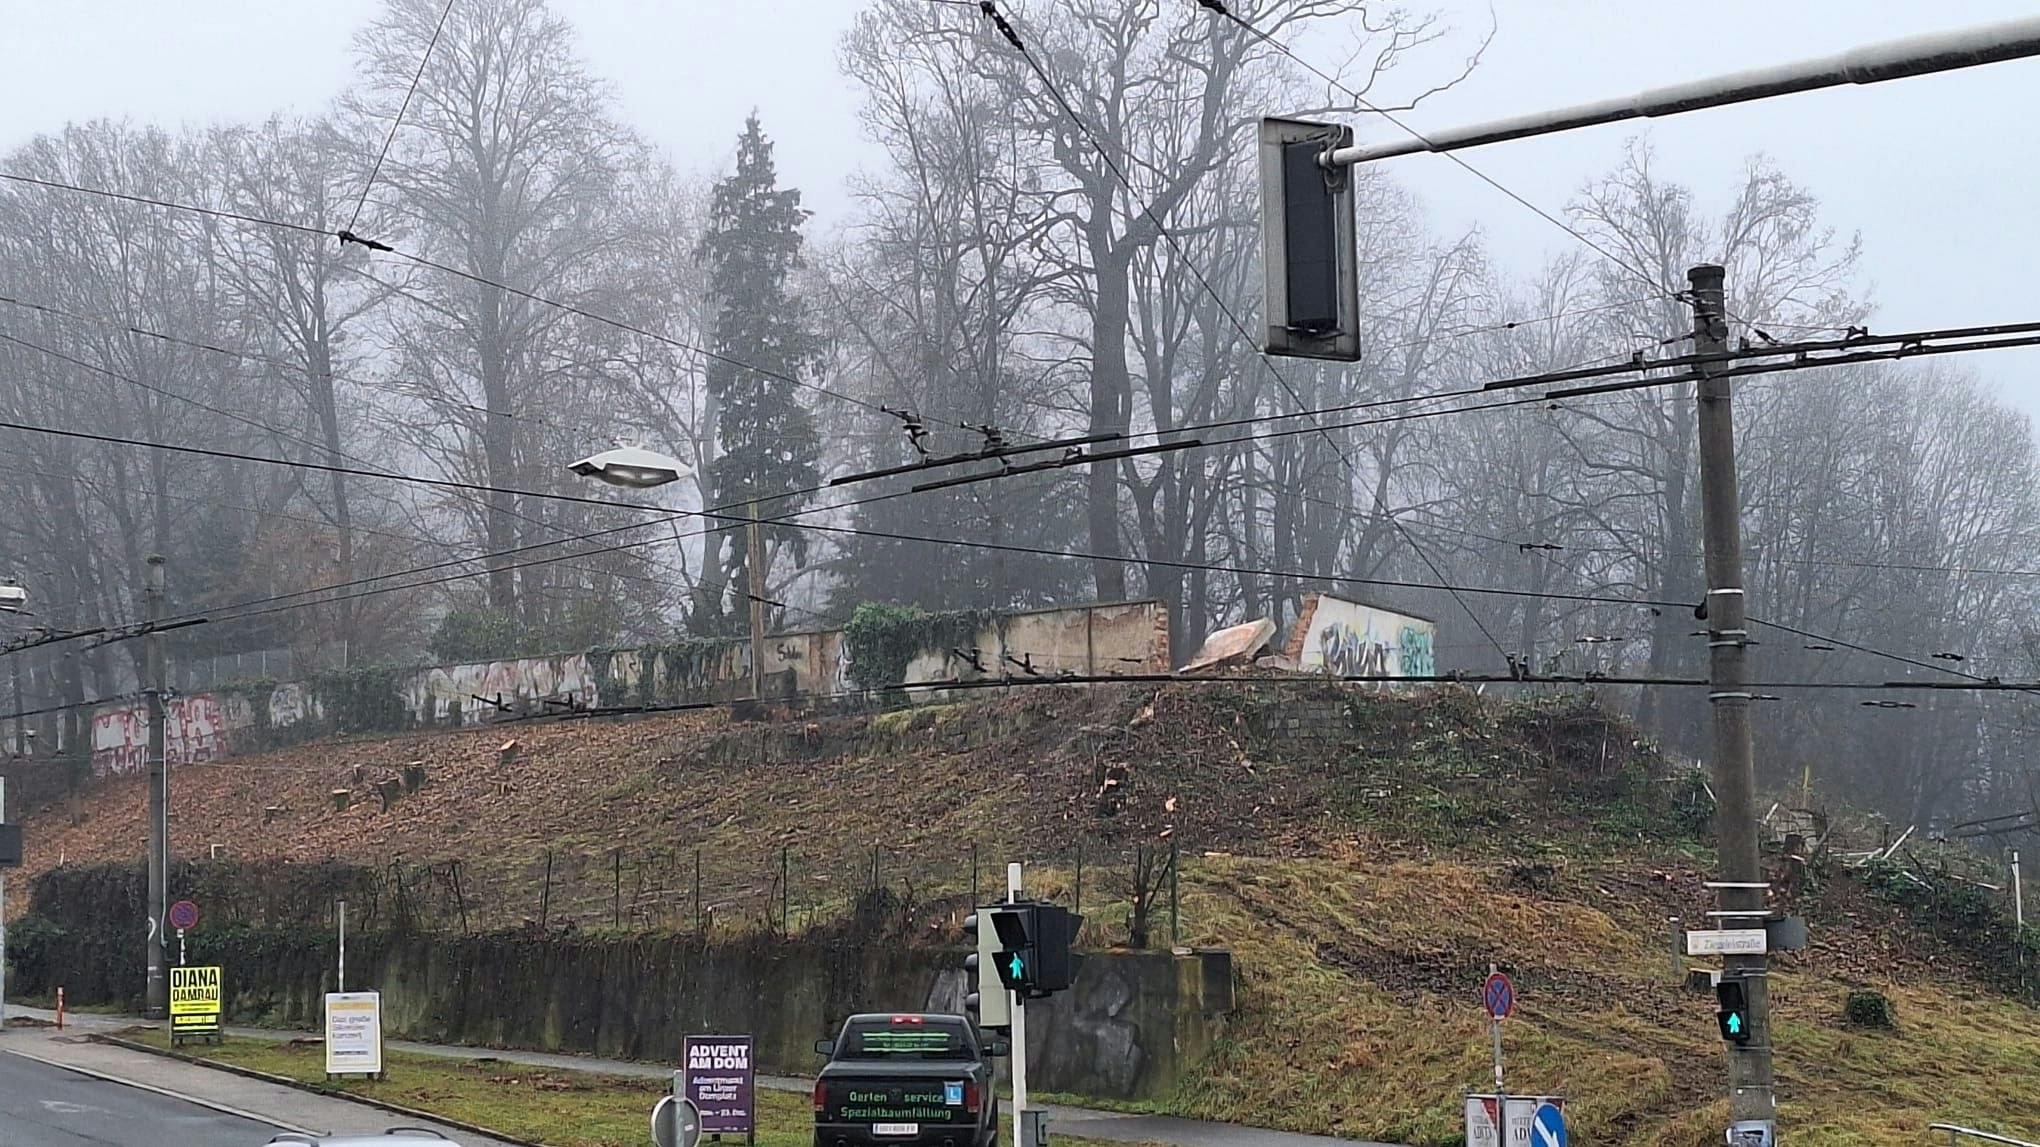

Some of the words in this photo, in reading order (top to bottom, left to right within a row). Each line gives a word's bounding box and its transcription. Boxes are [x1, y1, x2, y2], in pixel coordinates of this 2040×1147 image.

[173, 969, 218, 988] DIANA
[689, 1045, 748, 1057] ADVENT
[689, 1057, 711, 1069] AM
[713, 1057, 748, 1069] DOM
[849, 1091, 887, 1102] Garten
[904, 1092, 944, 1102] service
[950, 1089, 958, 1099] L
[840, 1106, 952, 1119] Spezialbaumfällung
